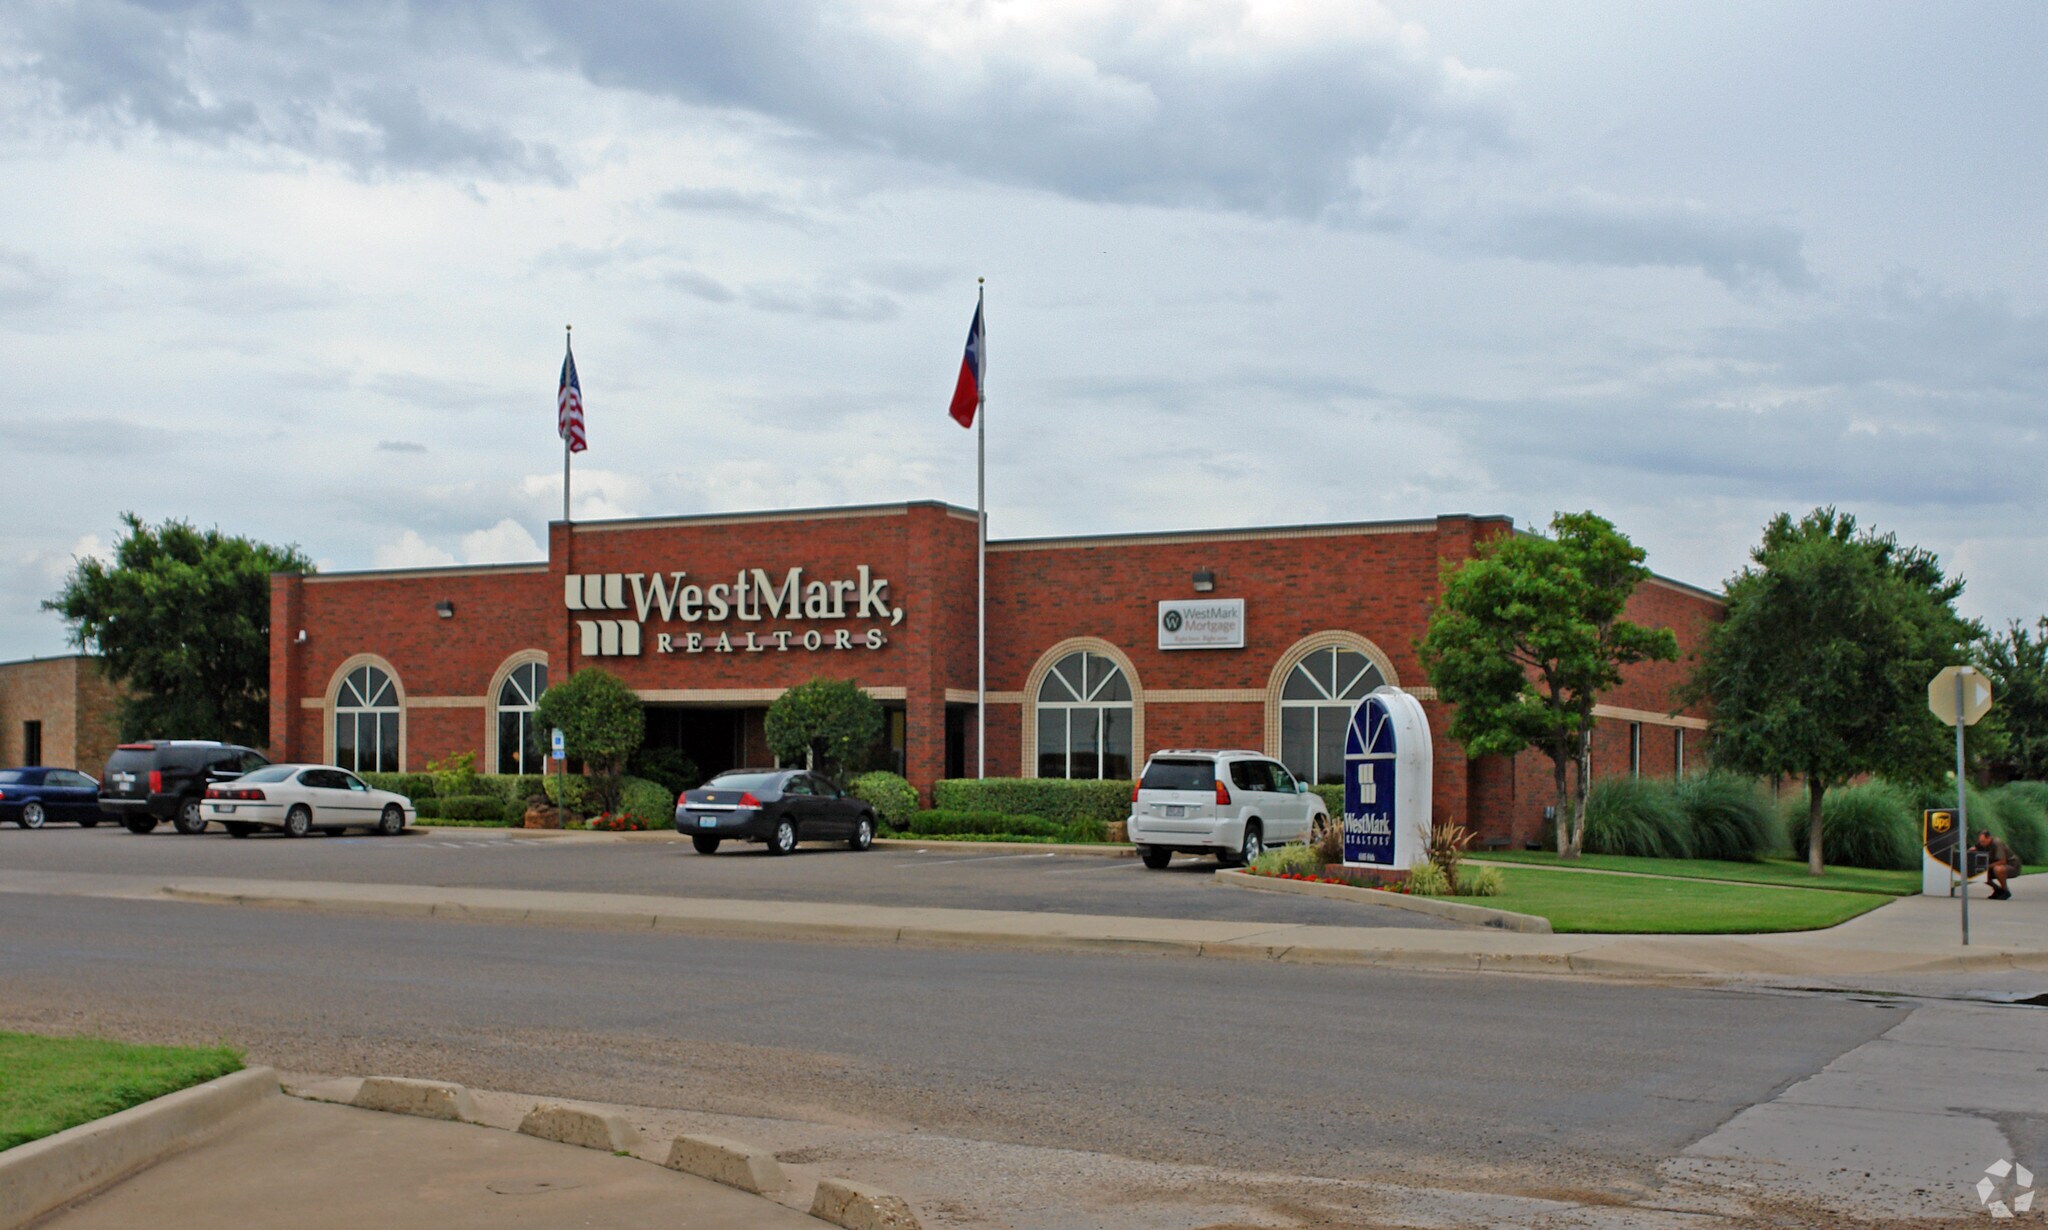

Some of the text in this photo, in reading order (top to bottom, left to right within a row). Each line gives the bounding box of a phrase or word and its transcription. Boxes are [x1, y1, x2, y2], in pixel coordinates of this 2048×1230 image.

[625, 565, 903, 626] WestMark,
[1183, 607, 1238, 619] WestMark
[1185, 620, 1236, 633] Mortgage
[657, 629, 882, 653] REALTORS
